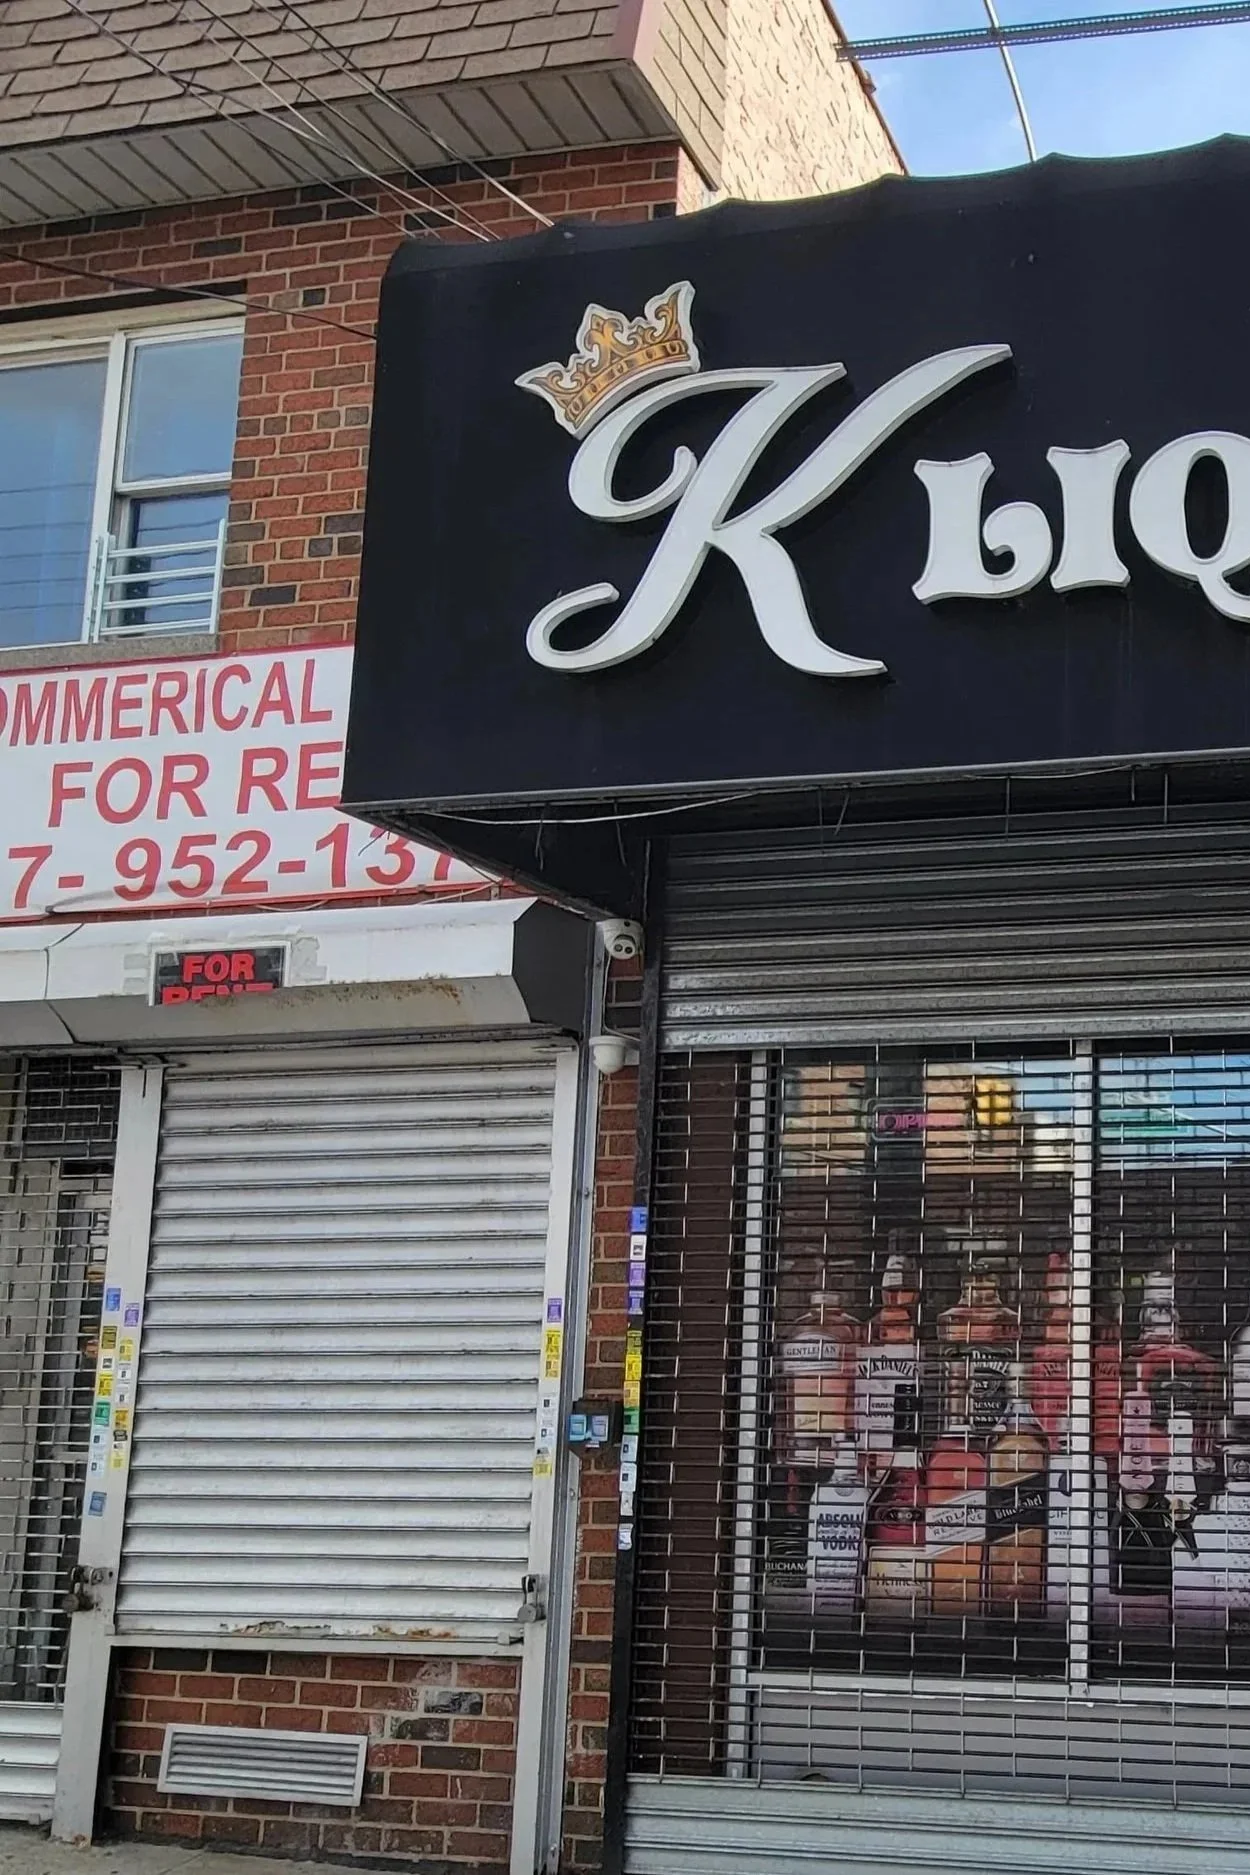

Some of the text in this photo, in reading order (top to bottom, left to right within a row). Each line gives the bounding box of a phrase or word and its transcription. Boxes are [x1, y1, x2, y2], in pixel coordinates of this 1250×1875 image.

[526, 343, 1011, 678] K
[0, 659, 333, 747] MMERICAL
[48, 754, 209, 828] FOR
[183, 953, 255, 983] FOR
